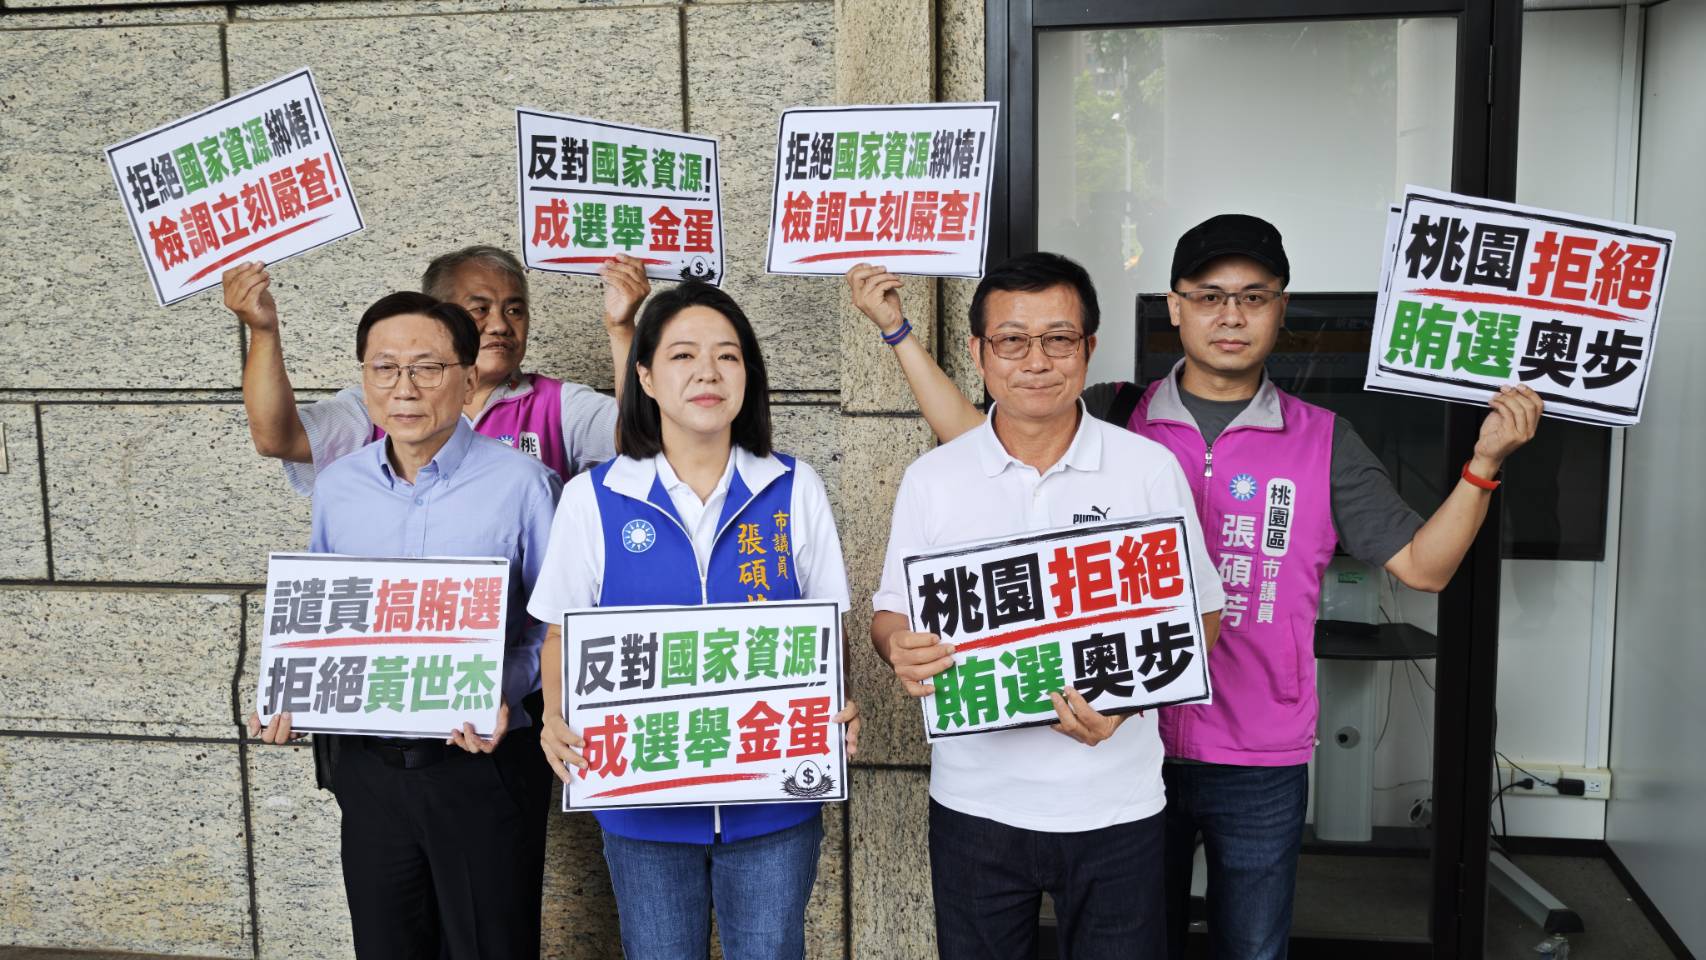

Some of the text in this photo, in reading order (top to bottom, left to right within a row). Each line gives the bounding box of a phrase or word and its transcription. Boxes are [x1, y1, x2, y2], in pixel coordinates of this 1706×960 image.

[528, 135, 712, 193] 反對國家資源!
[148, 152, 342, 271] 檢調立刻嚴查!
[531, 198, 715, 253] 成選舉金蛋
[781, 190, 981, 243] 檢調立刻嚴查!
[1405, 214, 1661, 311] 桃園拒絕
[1384, 300, 1644, 390] 賄選奧步
[521, 436, 538, 456] 桃
[737, 523, 771, 602] 張碩
[771, 509, 791, 580] 市議員
[918, 527, 1185, 639] 桃園拒絕
[1218, 514, 1257, 628] 張碩芳
[1256, 484, 1291, 624] 桃園區 市議員
[269, 576, 503, 636] 譴責搞賄選
[263, 653, 498, 716] 拒絕黃世杰
[575, 625, 831, 696] 反對國家資源!
[932, 620, 1195, 732] 賄選奧步
[577, 696, 832, 780] 成選舉金蛋
